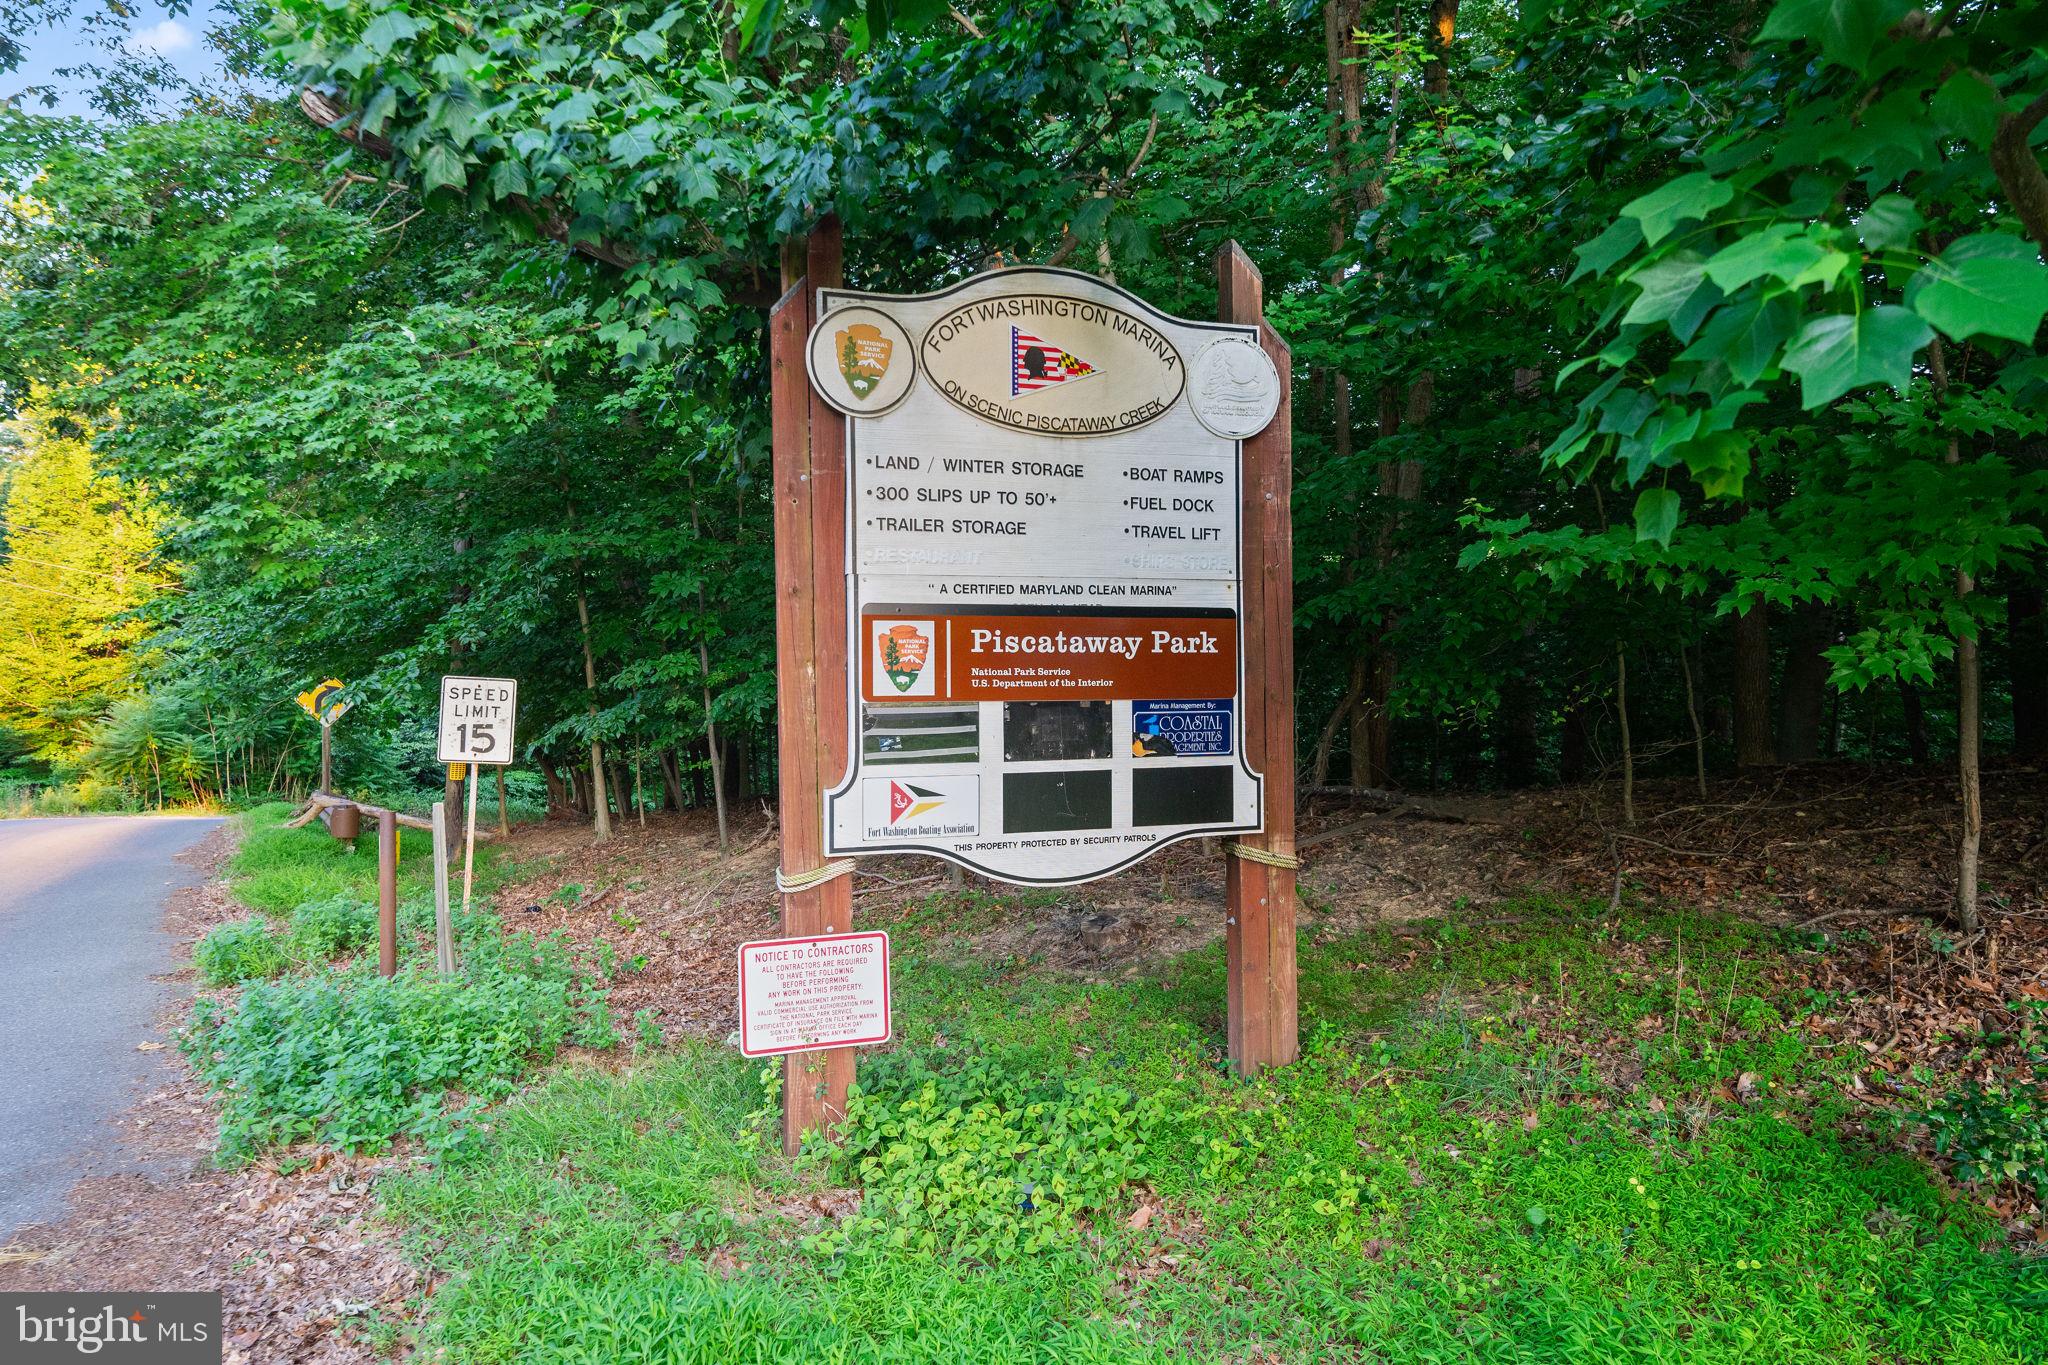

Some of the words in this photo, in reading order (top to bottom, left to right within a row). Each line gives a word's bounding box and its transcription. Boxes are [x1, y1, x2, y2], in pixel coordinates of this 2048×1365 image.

[928, 308, 976, 353] FORT
[979, 299, 1109, 327] WASHINGTON
[1112, 314, 1177, 371] MARINA
[857, 339, 888, 348] NATIONAL
[944, 380, 968, 402] ON
[968, 394, 1023, 425] SCENIC
[1026, 413, 1117, 432] PISCATAWAY
[1119, 396, 1165, 426] CREEK
[875, 455, 920, 471] LAND
[943, 458, 1004, 474] WINTER
[1012, 461, 1084, 478] STORAGE
[1130, 467, 1167, 481] BOAT
[1174, 469, 1224, 484] RAMPS
[876, 486, 909, 501] 300
[917, 488, 963, 503] SLIPS
[970, 490, 991, 504] UP
[997, 491, 1018, 505] TO
[1130, 496, 1167, 511] FUEL
[1172, 498, 1215, 513] DOCK
[876, 517, 944, 533] TRAILER
[952, 519, 1027, 535] STORAGE
[1132, 525, 1186, 540] TRAVEL
[1191, 527, 1221, 541] LIFT
[953, 584, 1015, 595] CERTIFIED
[1019, 584, 1084, 596] MARYLAND
[1088, 584, 1126, 596] CLEAN
[970, 628, 1143, 660] Piscataway
[1150, 630, 1219, 655] Park
[971, 667, 1013, 676] National
[1013, 667, 1036, 676] Park
[1037, 667, 1071, 676] Service
[971, 679, 990, 688] U.S.
[992, 679, 1048, 689] Department
[1050, 678, 1059, 687] of
[1061, 678, 1076, 687] the
[1077, 678, 1114, 687] Interior
[449, 687, 509, 701] SPEED
[455, 705, 501, 718] LIMIT
[1170, 702, 1206, 710] Management
[1207, 702, 1216, 710] By:
[1159, 715, 1223, 731] COASTAL
[457, 724, 496, 754] 15
[1208, 742, 1223, 751] INC.
[868, 827, 881, 837] Fort
[883, 825, 917, 837] Washington
[919, 824, 941, 836] Boating
[943, 823, 975, 834] Association
[954, 844, 973, 852] THIS
[975, 841, 1018, 850] PROPERTY
[1021, 838, 1067, 848] PROTECTED
[1070, 838, 1080, 846] BY
[1083, 836, 1121, 845] SECURITY
[1124, 834, 1157, 842] PATROLS
[755, 950, 789, 963] NOTICE
[793, 949, 804, 959] TO
[807, 943, 874, 958] CONTRACTORS
[762, 965, 773, 973] ALL
[776, 961, 821, 972] CONTRACTORS
[822, 960, 836, 968] ARE
[837, 957, 868, 966] REQUIRED
[819, 967, 854, 977] FOLLOWING
[782, 980, 806, 989] BEFORE
[809, 976, 849, 986] PERFORMING
[783, 990, 801, 998] WORK
[814, 986, 828, 994] THIS
[830, 983, 863, 992] PROPERTY:
[774, 1006, 806, 1014] COMMERCIAL
[820, 1001, 858, 1010] AUTHORIZATION
[796, 997, 829, 1005] MANAGEMENT
[791, 1012, 815, 1020] NATIONAL
[832, 1008, 852, 1016] SERVICE
[753, 1022, 785, 1031] CERTIFICATE
[795, 1018, 823, 1026] INSURANCE
[776, 1035, 795, 1043] BEFORE
